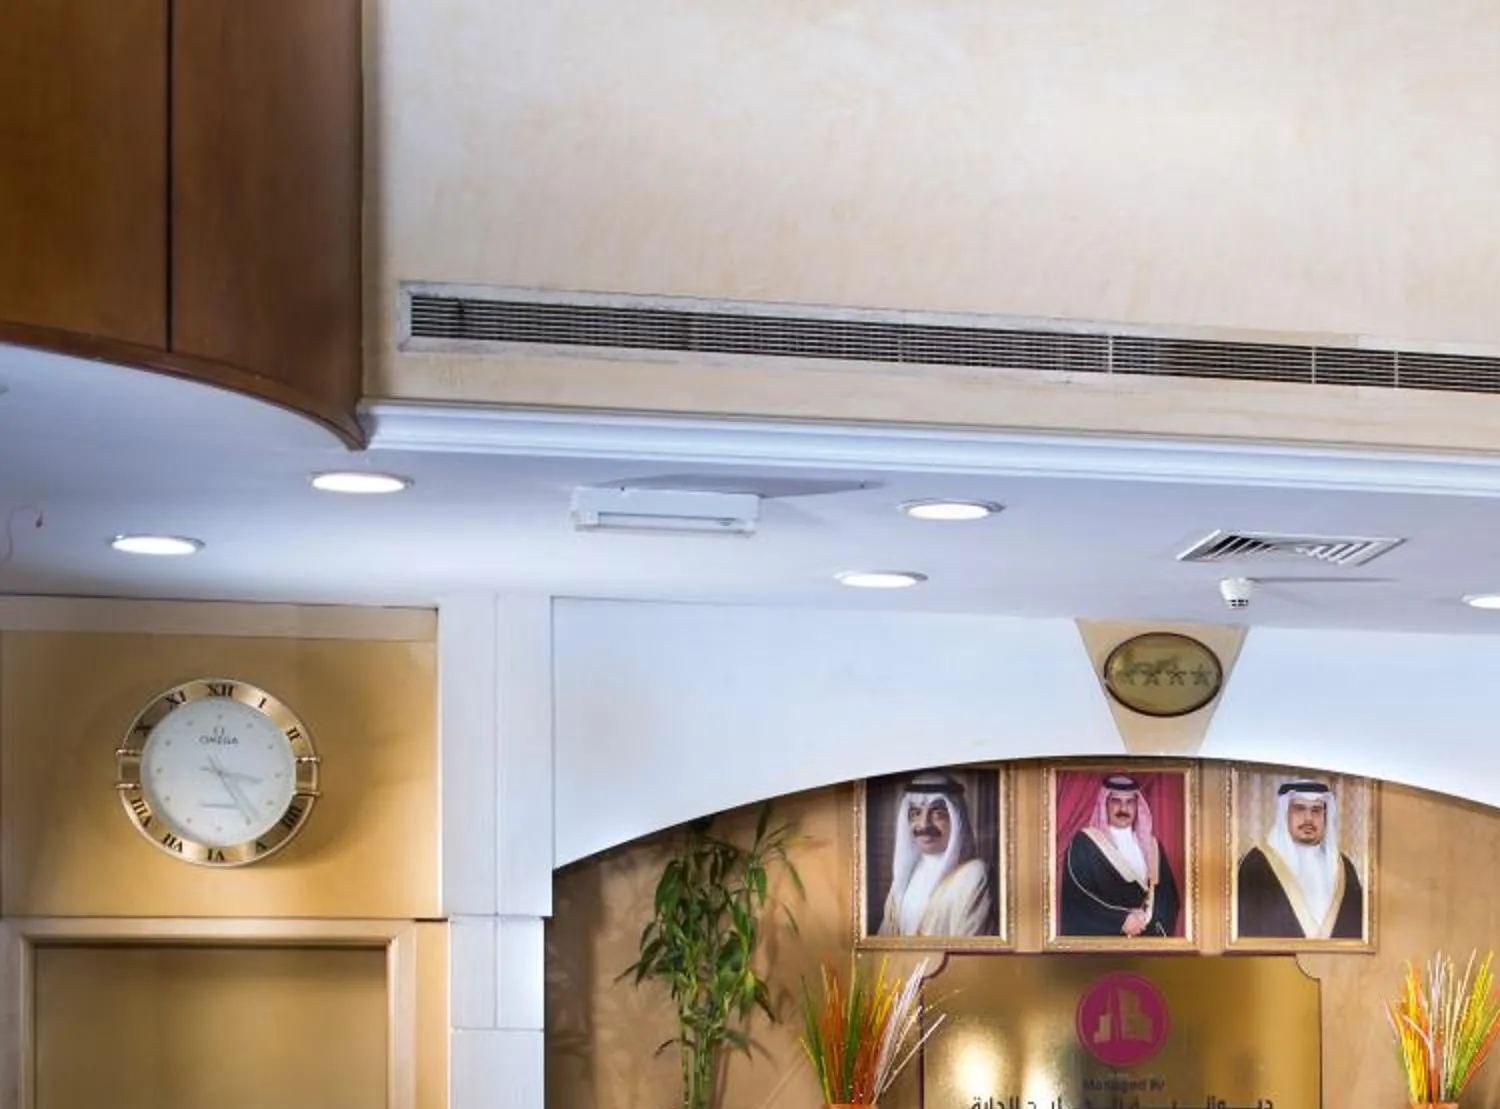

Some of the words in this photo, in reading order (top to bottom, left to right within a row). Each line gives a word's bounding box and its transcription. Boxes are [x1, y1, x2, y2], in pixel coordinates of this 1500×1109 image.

[207, 684, 235, 698] XII
[200, 735, 238, 745] OMEGA
[286, 726, 300, 742] II
